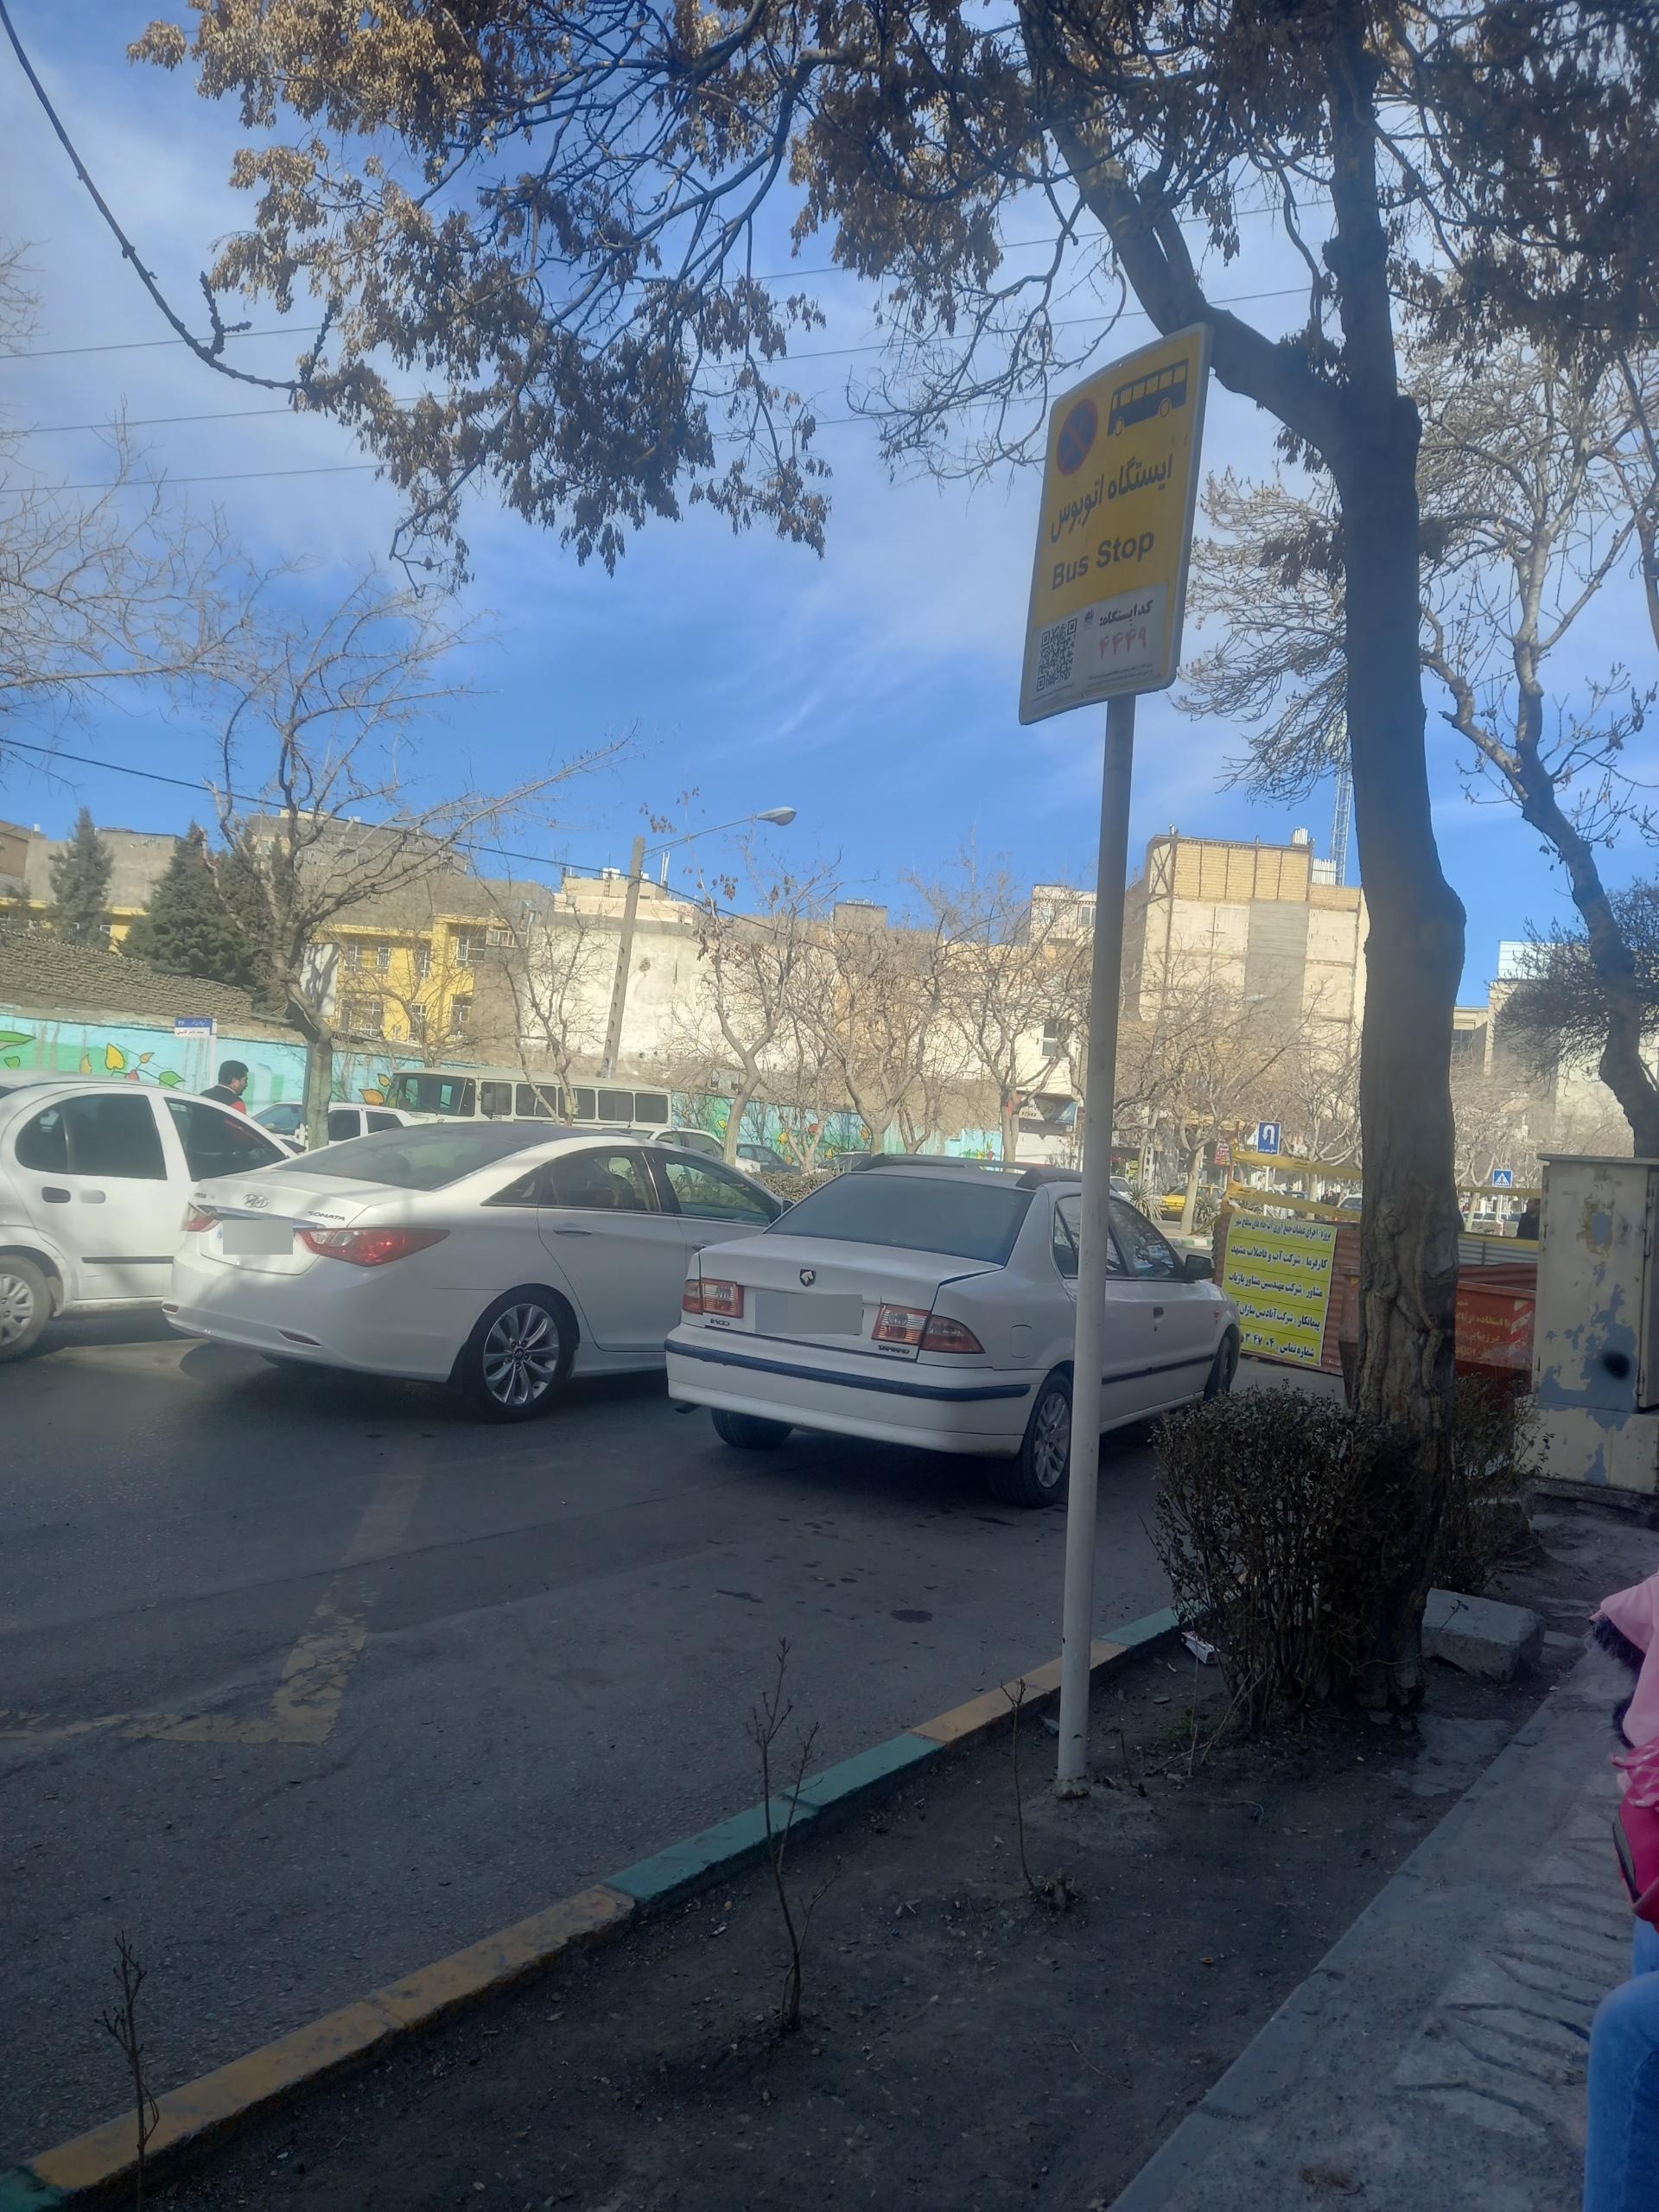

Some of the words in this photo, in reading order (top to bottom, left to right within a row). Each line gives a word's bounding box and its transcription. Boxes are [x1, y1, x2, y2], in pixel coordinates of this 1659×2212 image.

[1108, 453, 1173, 499] ایستگاه
[1051, 474, 1105, 543] اتوبوس
[1051, 556, 1089, 590] Bus
[1096, 531, 1154, 568] Stop
[308, 1211, 346, 1221] SONATA
[1306, 1226, 1319, 1239] اجرای
[1230, 1245, 1246, 1256] مشهد
[1247, 1247, 1268, 1261] فاضلاب
[1273, 1250, 1282, 1262] آب
[1283, 1254, 1301, 1267] شرکت
[1306, 1255, 1328, 1271] کارفرما
[1244, 1274, 1261, 1287] مشاور
[1261, 1281, 1284, 1292] مهندسین
[1286, 1282, 1302, 1296] شرکت
[1306, 1285, 1323, 1299] مشاور
[1277, 1312, 1294, 1325] شرکت
[1298, 1314, 1320, 1331] پیمانکار
[1280, 1342, 1296, 1354] تماس
[1296, 1346, 1314, 1357] شماره
